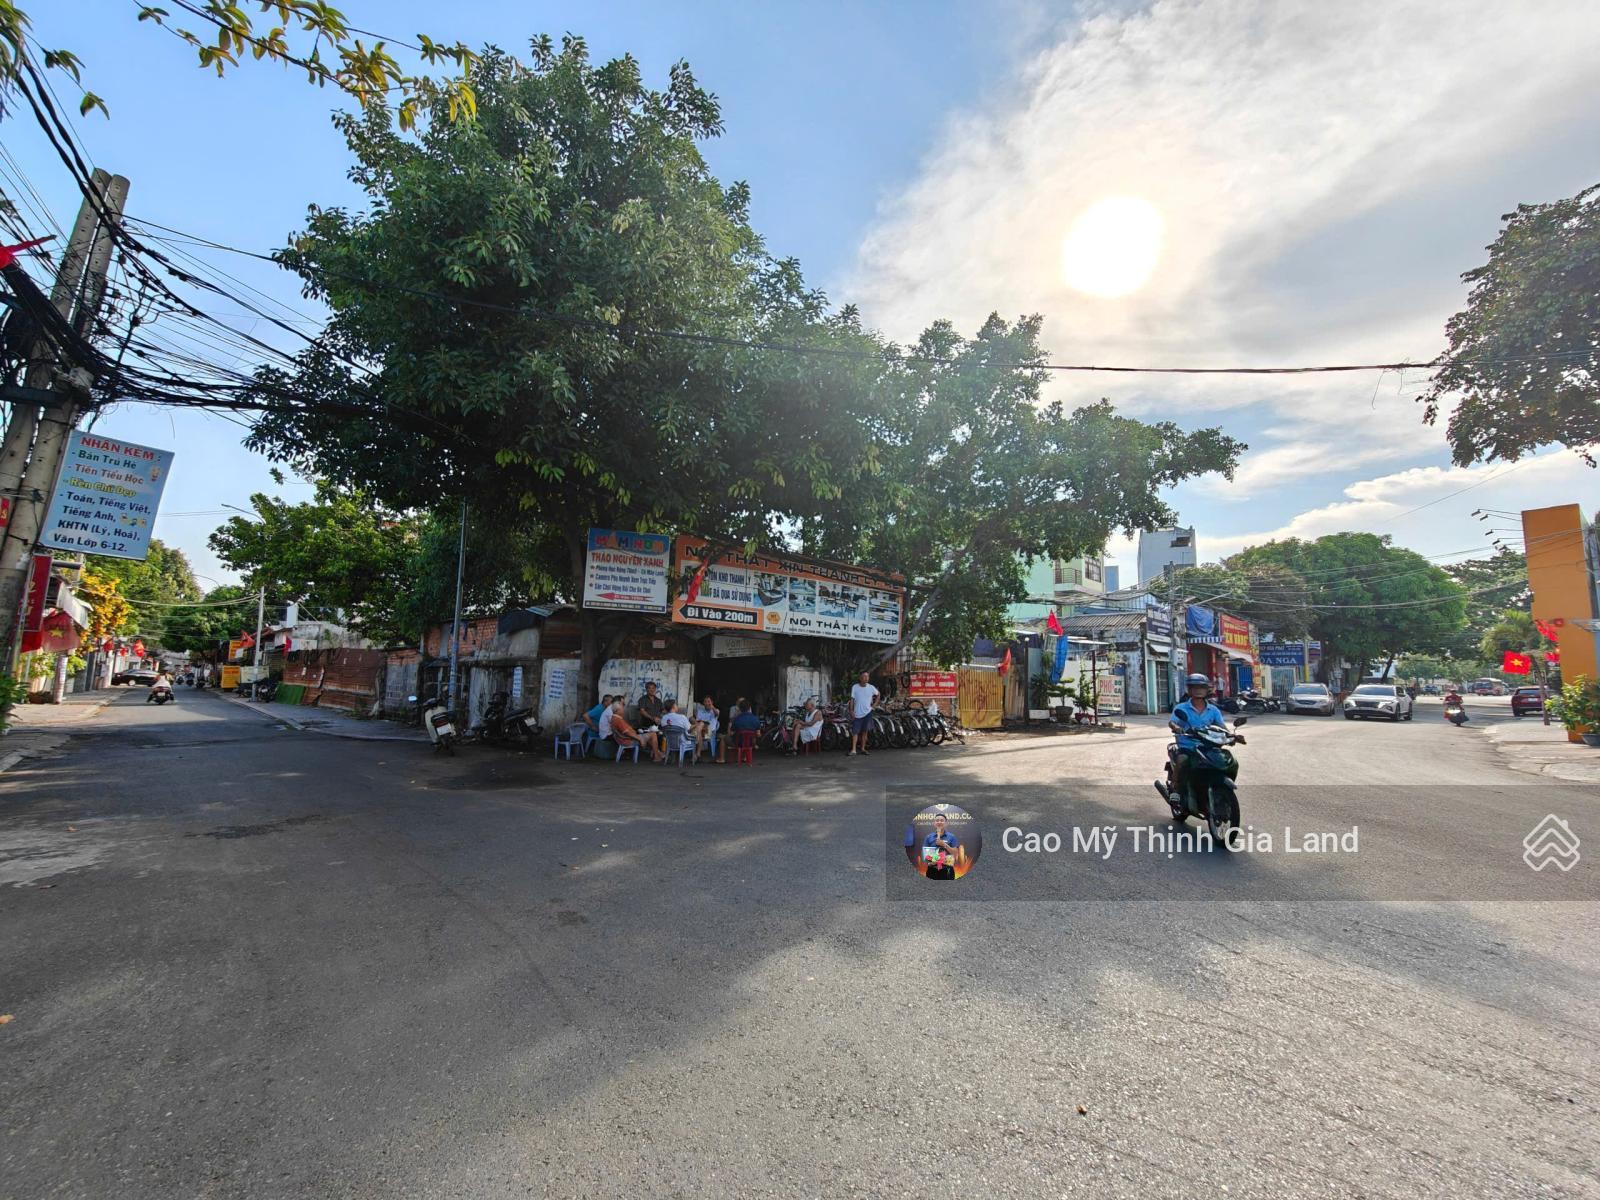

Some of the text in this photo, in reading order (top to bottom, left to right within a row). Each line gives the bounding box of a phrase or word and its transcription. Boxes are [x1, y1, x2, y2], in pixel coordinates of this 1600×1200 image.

[78, 450, 100, 463] Bán
[124, 473, 144, 486] Học
[66, 491, 151, 515] Toán, Tiếng Việt,
[62, 505, 117, 523] Tiếng Anh,
[57, 519, 89, 532] KHTN
[77, 536, 98, 549] Lớp
[100, 540, 128, 553] 6-12.
[687, 606, 699, 617] Đi
[702, 608, 722, 620] Vào
[725, 611, 754, 623] 200m
